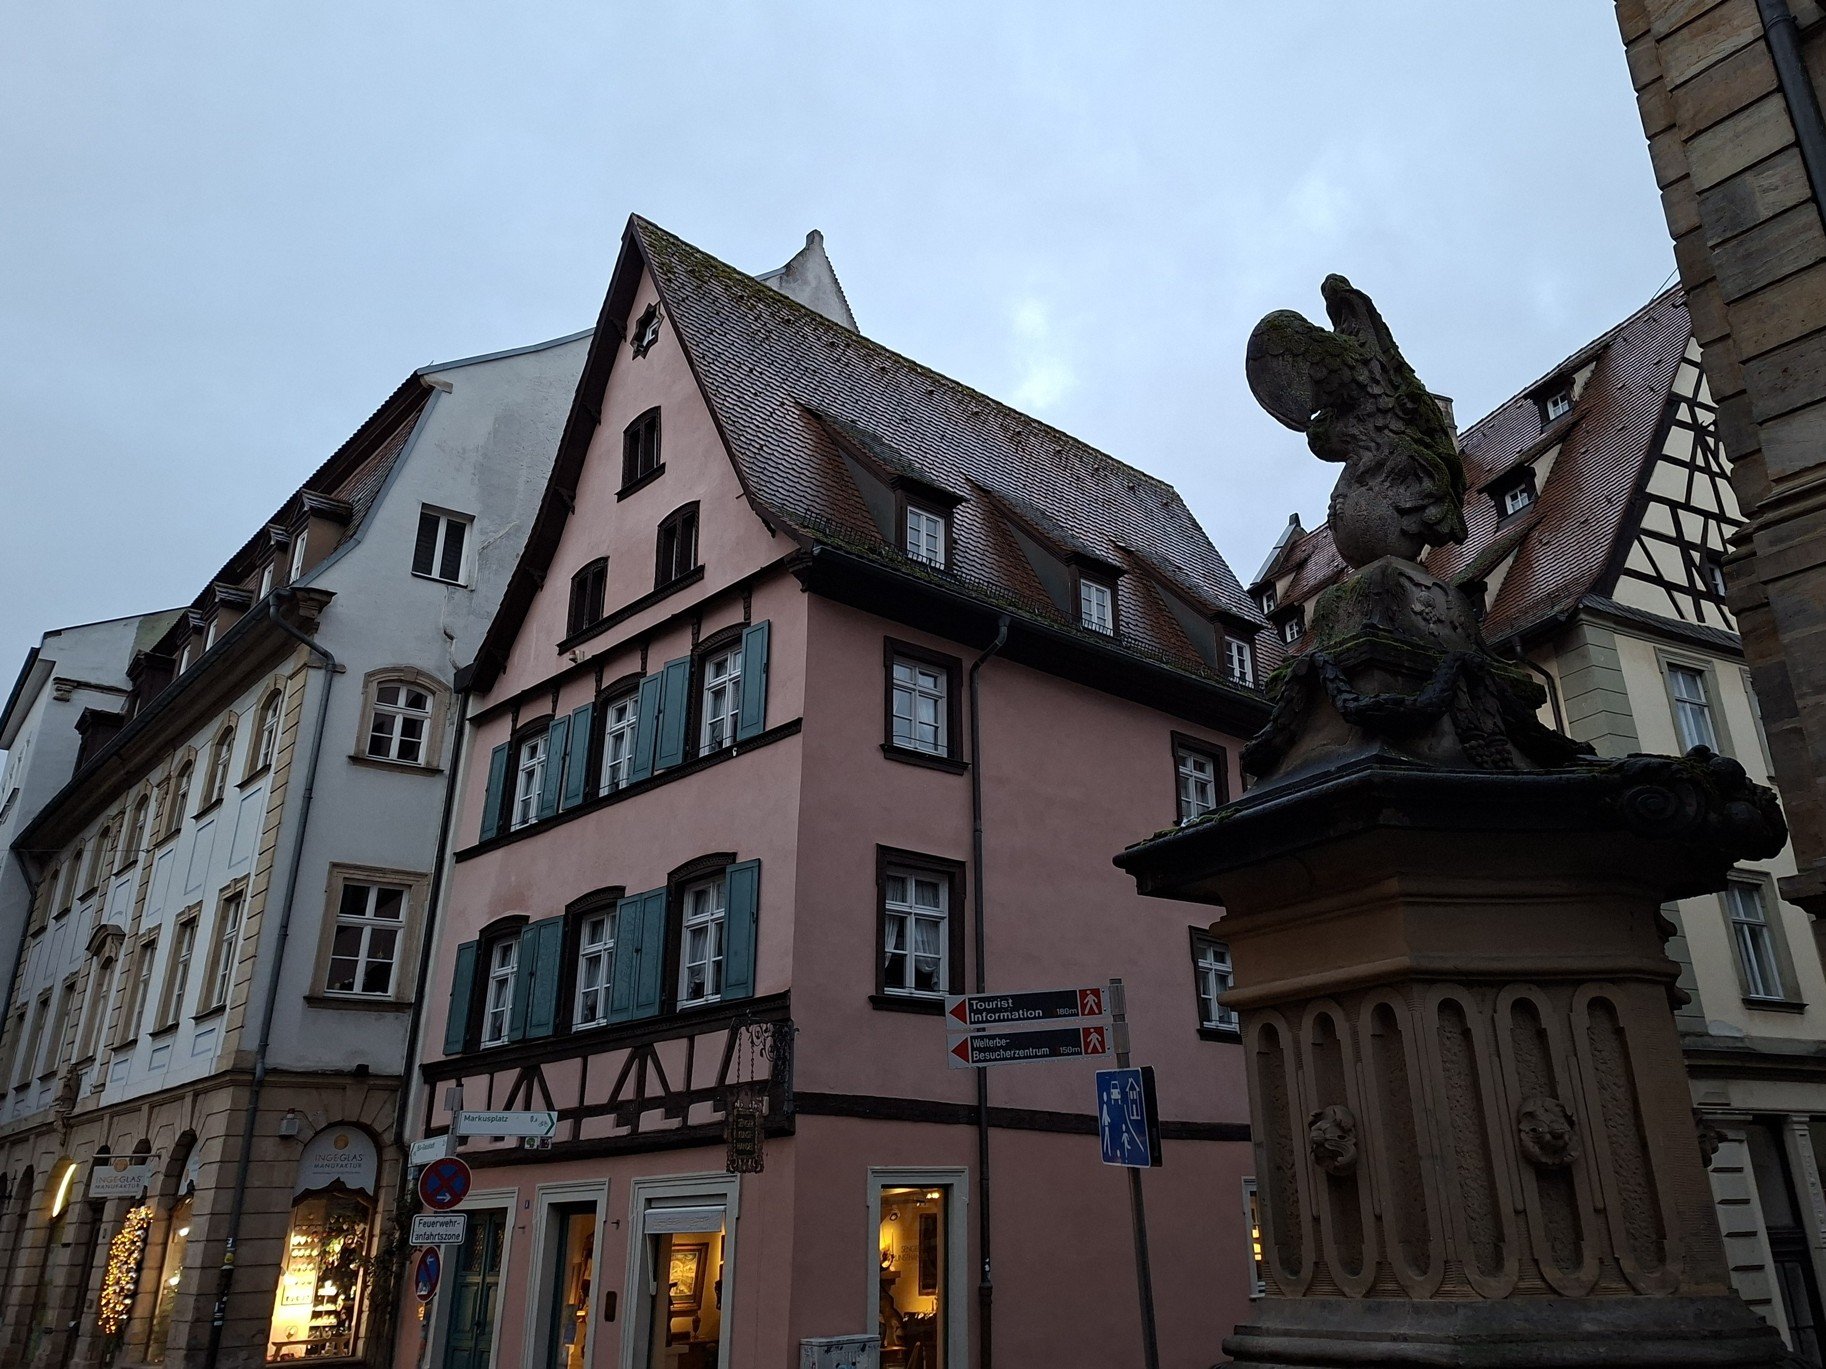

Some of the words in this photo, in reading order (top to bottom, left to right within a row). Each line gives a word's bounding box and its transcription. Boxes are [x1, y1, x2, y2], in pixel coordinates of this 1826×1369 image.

[970, 998, 1013, 1010] Tourist
[970, 1008, 1043, 1022] Information
[1056, 1008, 1078, 1016] 180m
[972, 1038, 1010, 1048] Welterbe-
[972, 1047, 1050, 1061] Besucherzentrum
[1060, 1046, 1081, 1054] 150m
[463, 1115, 509, 1124] Markusplatz
[417, 1218, 461, 1228] Feuerwehr-
[414, 1231, 461, 1241] anfahrtszone
